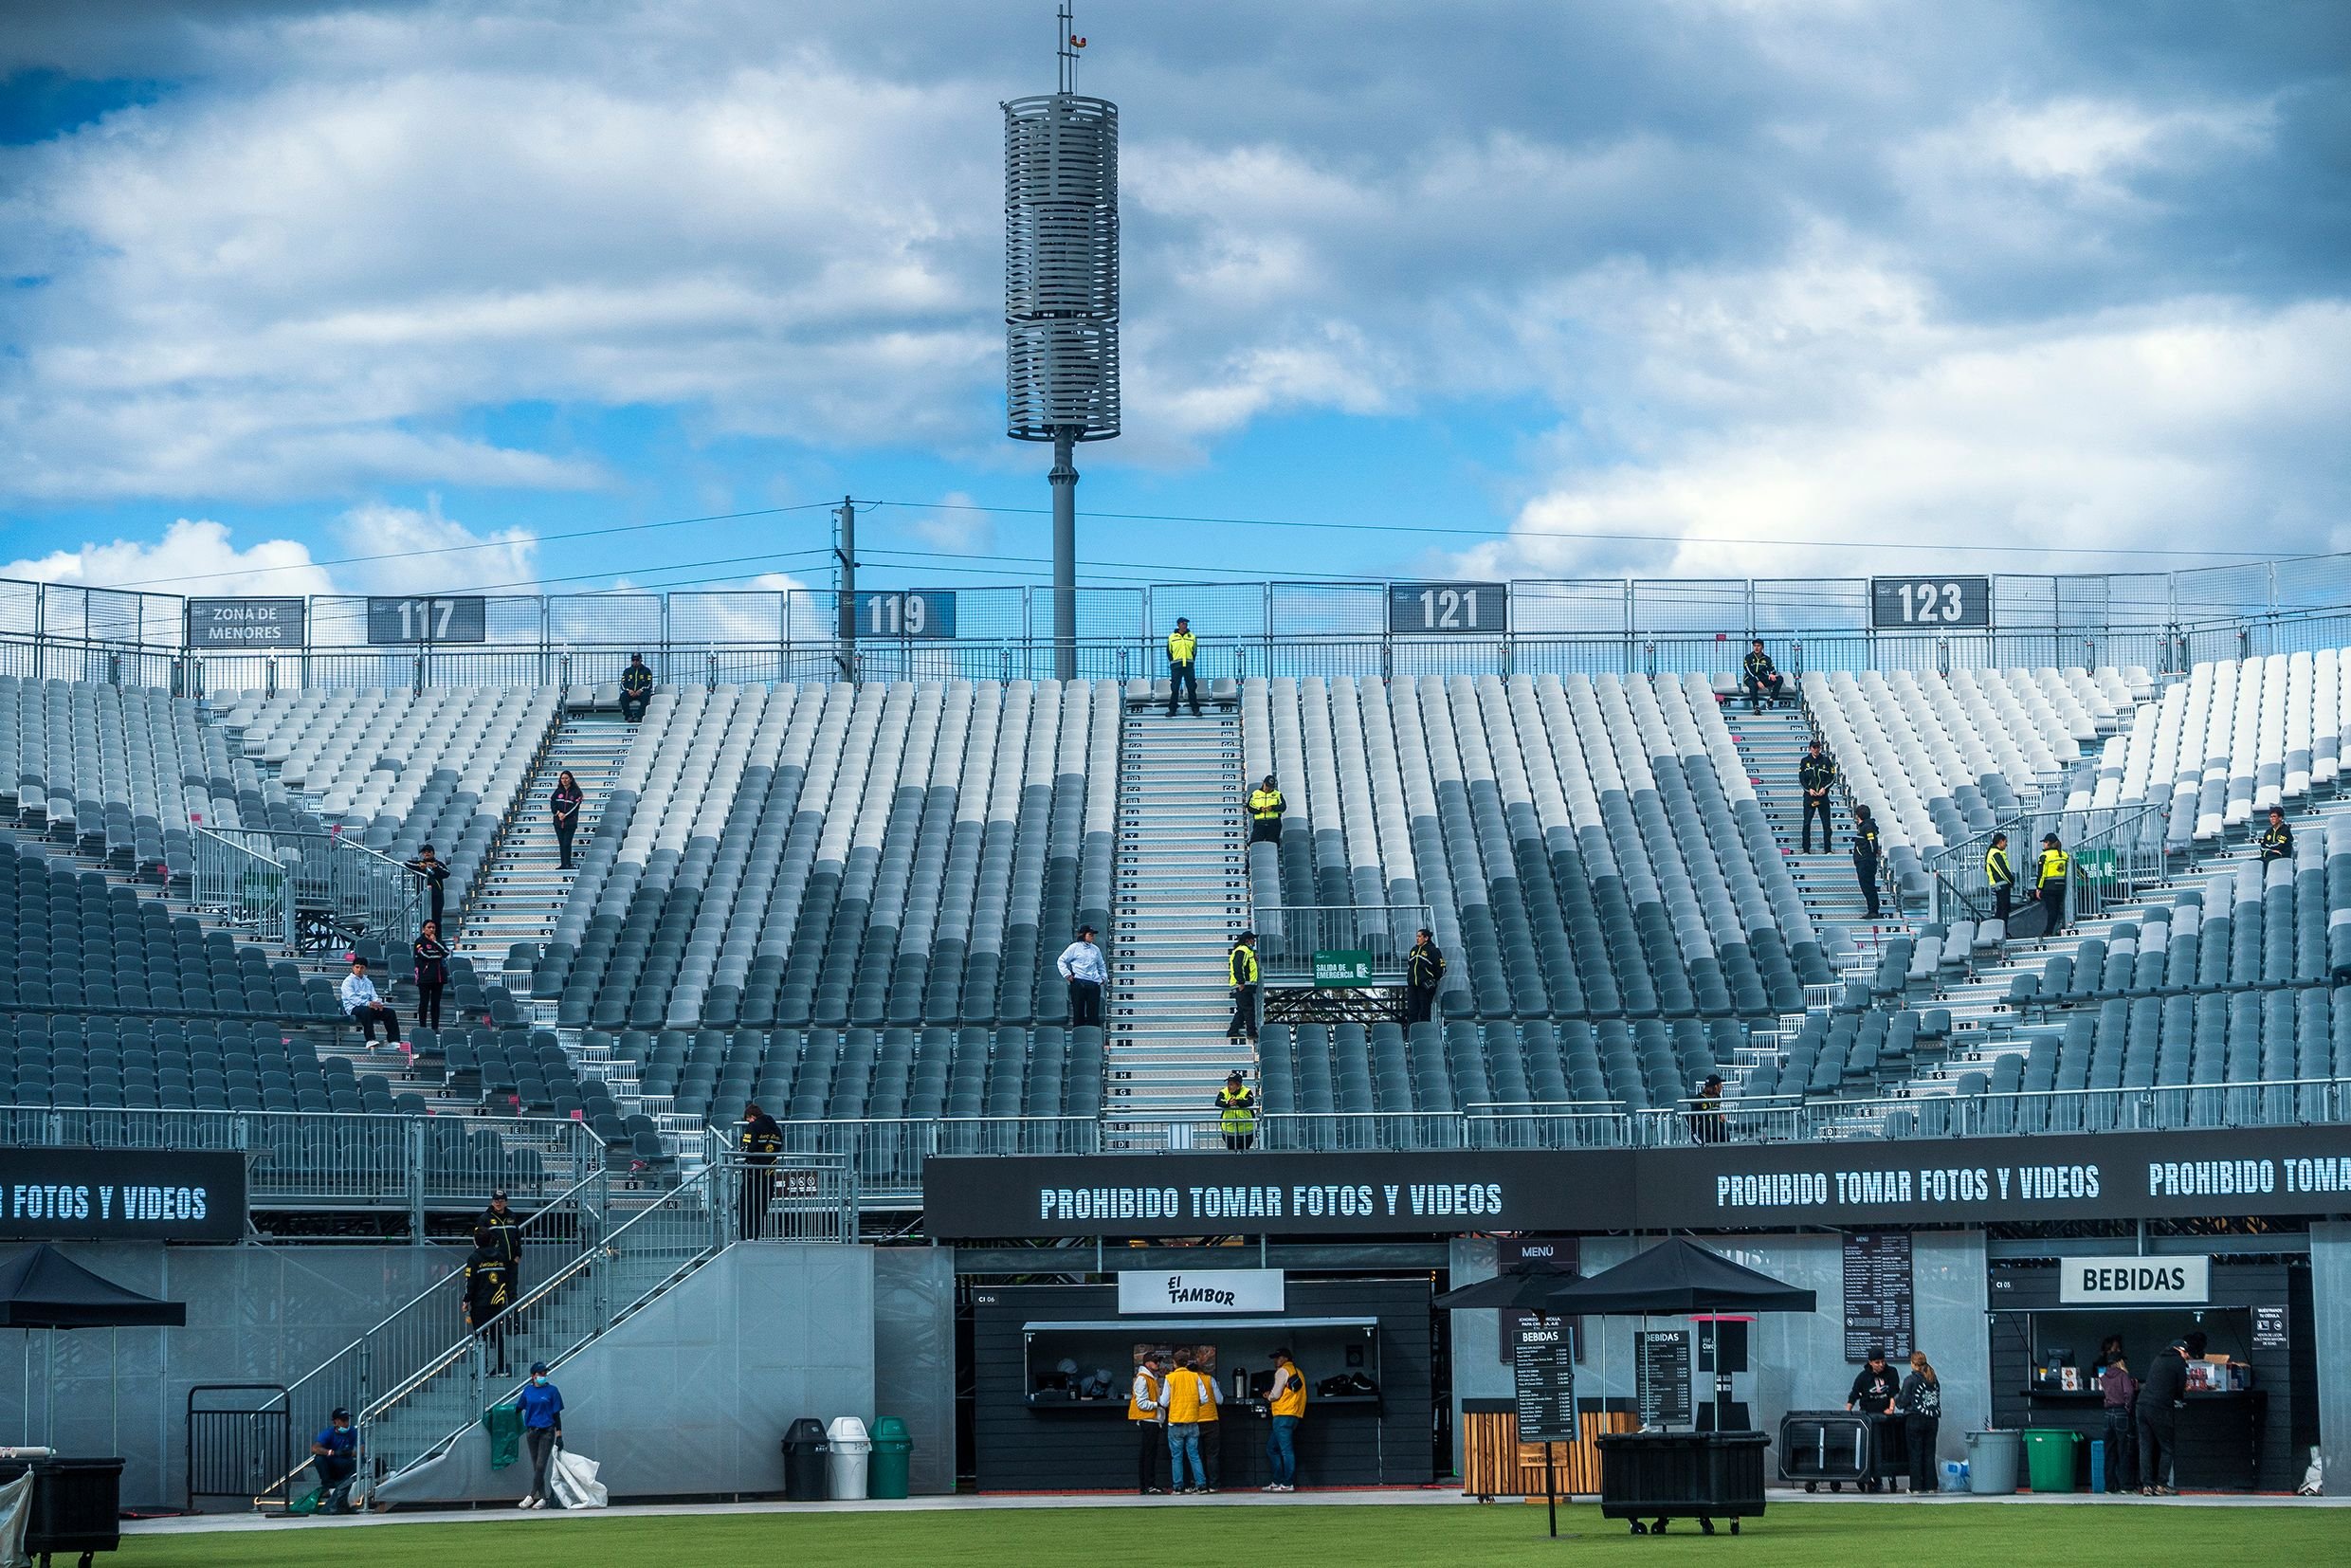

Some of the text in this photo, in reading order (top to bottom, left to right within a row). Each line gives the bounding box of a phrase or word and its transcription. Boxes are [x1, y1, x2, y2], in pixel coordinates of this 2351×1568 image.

[213, 608, 254, 620] ZONA
[259, 608, 277, 620] DE
[398, 601, 455, 639] 117
[867, 595, 925, 634] 119
[1420, 590, 1477, 629] 121
[1898, 583, 1962, 622] 123
[209, 627, 282, 640] MENORES
[1717, 1164, 2100, 1207] PROHIBIDO TOMAR FOTOS Y VIDEOS
[2149, 1159, 2275, 1196] PROHIBIDO
[13, 1185, 89, 1219] FOTOS
[99, 1185, 114, 1219] Y
[123, 1186, 207, 1220] VIDEOS
[1041, 1183, 1503, 1220] PROHIBIDO TOMAR FOTOS Y VIDEOS
[1168, 1288, 1235, 1306] TAMBOR
[2083, 1267, 2185, 1291] BEBIDAS
[1522, 1331, 1558, 1342] BEBIDAS
